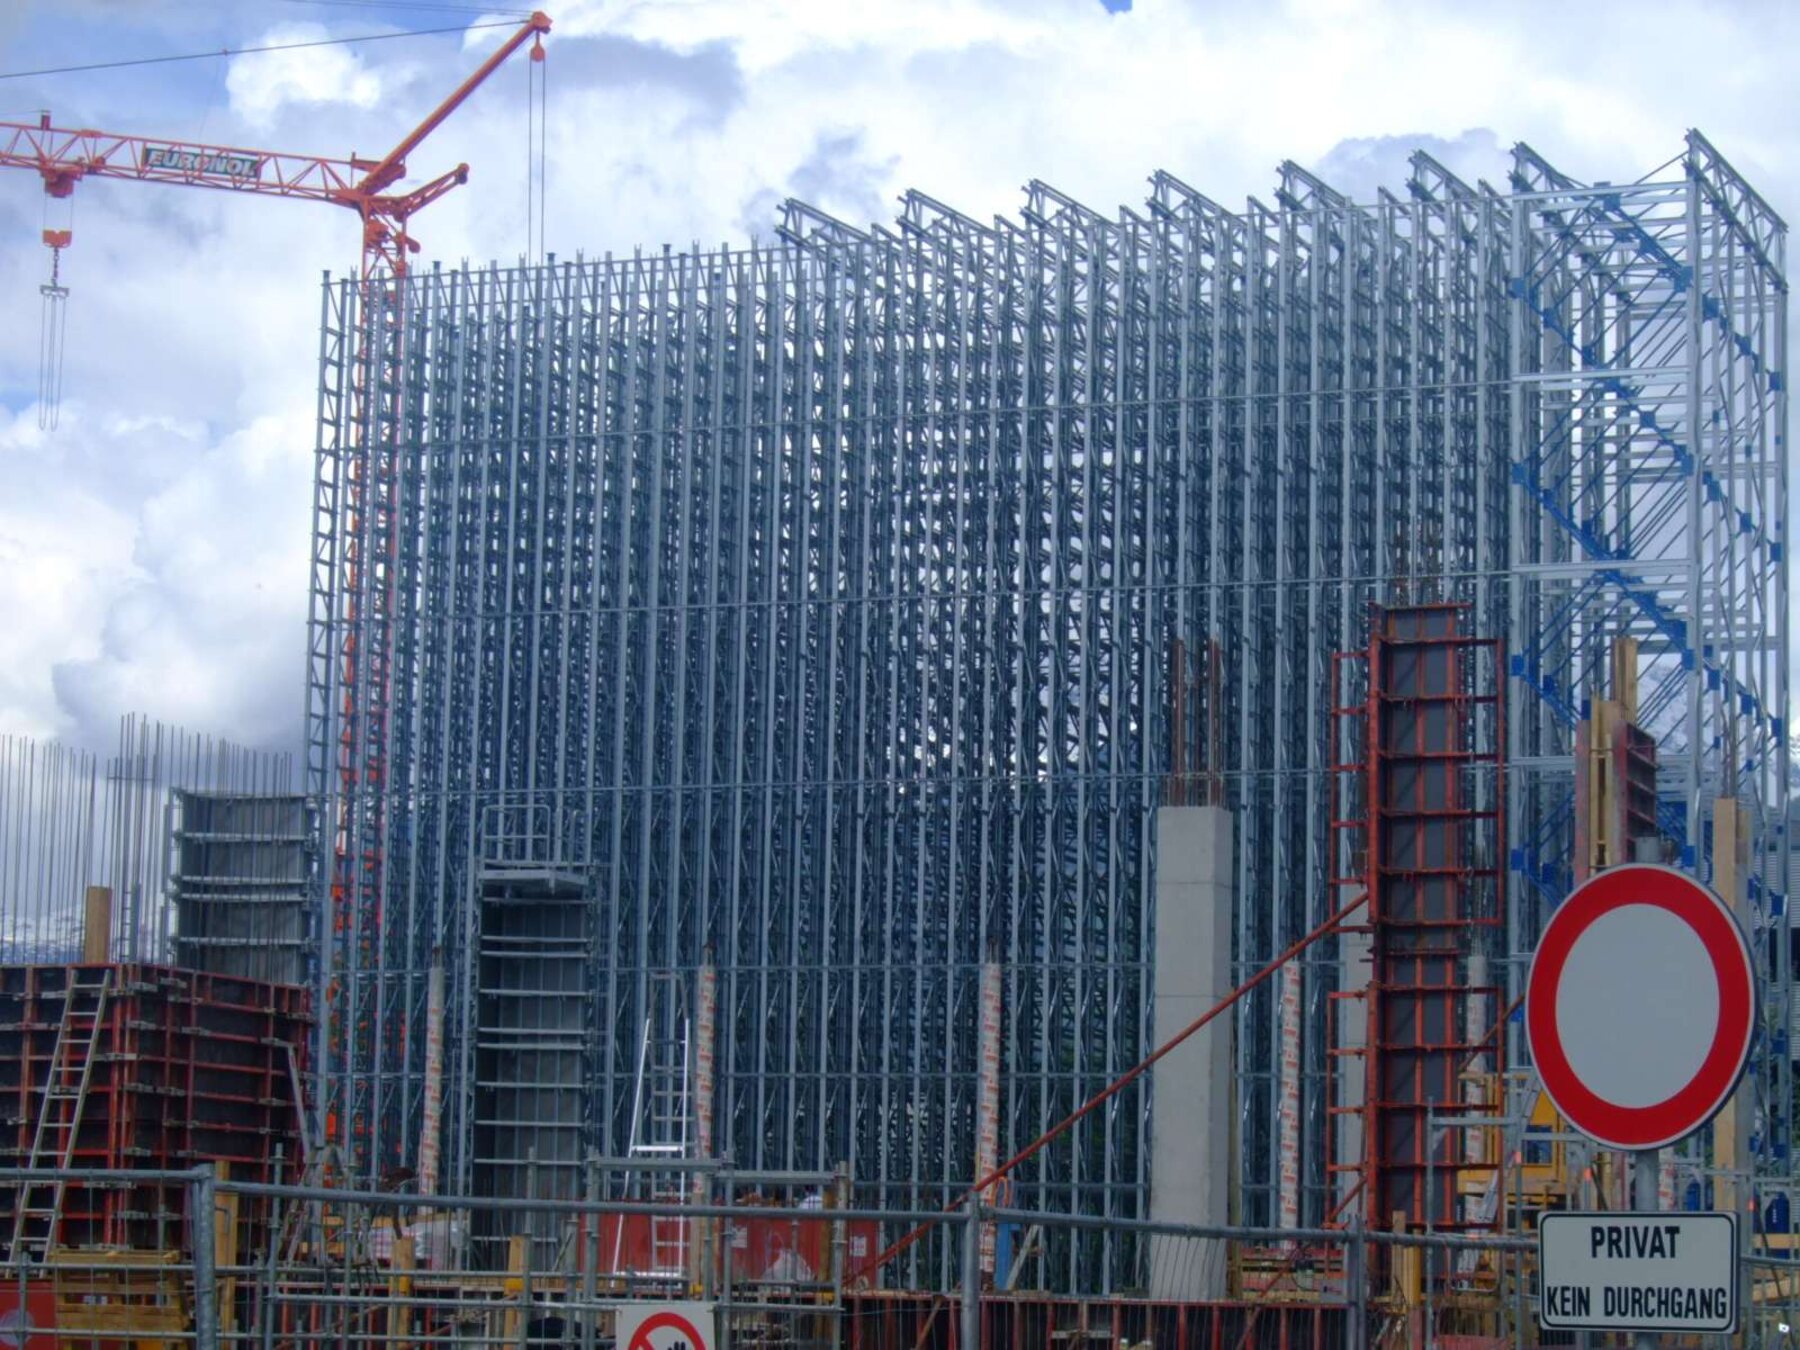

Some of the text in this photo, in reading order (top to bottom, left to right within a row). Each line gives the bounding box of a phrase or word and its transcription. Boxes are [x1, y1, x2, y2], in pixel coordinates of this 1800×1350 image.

[1591, 1225, 1680, 1259] PRIVAT
[1547, 1286, 1727, 1319] KEIN DURCHGANG
